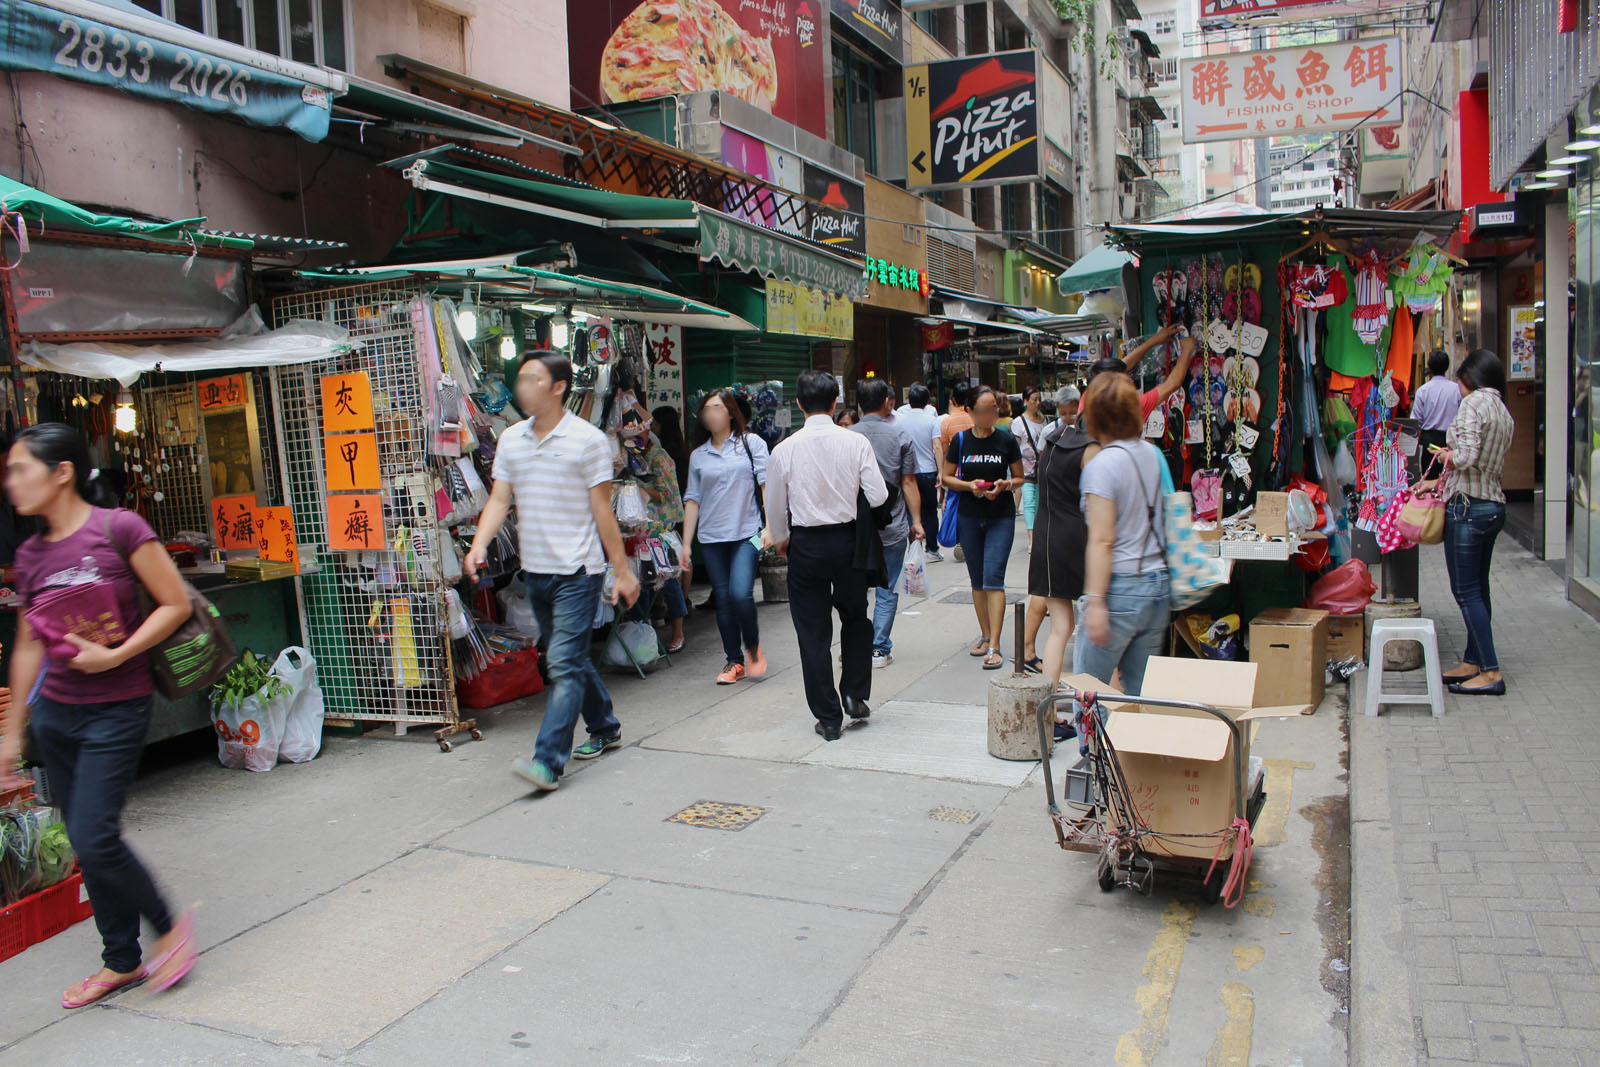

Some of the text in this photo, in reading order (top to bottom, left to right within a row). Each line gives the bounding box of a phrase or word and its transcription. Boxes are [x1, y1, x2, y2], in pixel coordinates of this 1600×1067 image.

[799, 29, 814, 43] Hut
[881, 9, 899, 37] Hut
[54, 19, 155, 84] 2833
[169, 50, 252, 107] 2026
[1191, 43, 1394, 107] 聯盛魚餌
[907, 75, 927, 99] 1/F
[1226, 96, 1354, 118] FISHING SHOP
[934, 90, 1036, 166] Pizza
[1254, 113, 1327, 131] 巷口直入
[952, 117, 1027, 174] Hut
[839, 214, 859, 236] Hut
[716, 223, 788, 272] 錦波原子印
[788, 251, 812, 278] TEL
[651, 323, 677, 366] 波
[984, 455, 1002, 464] FAN
